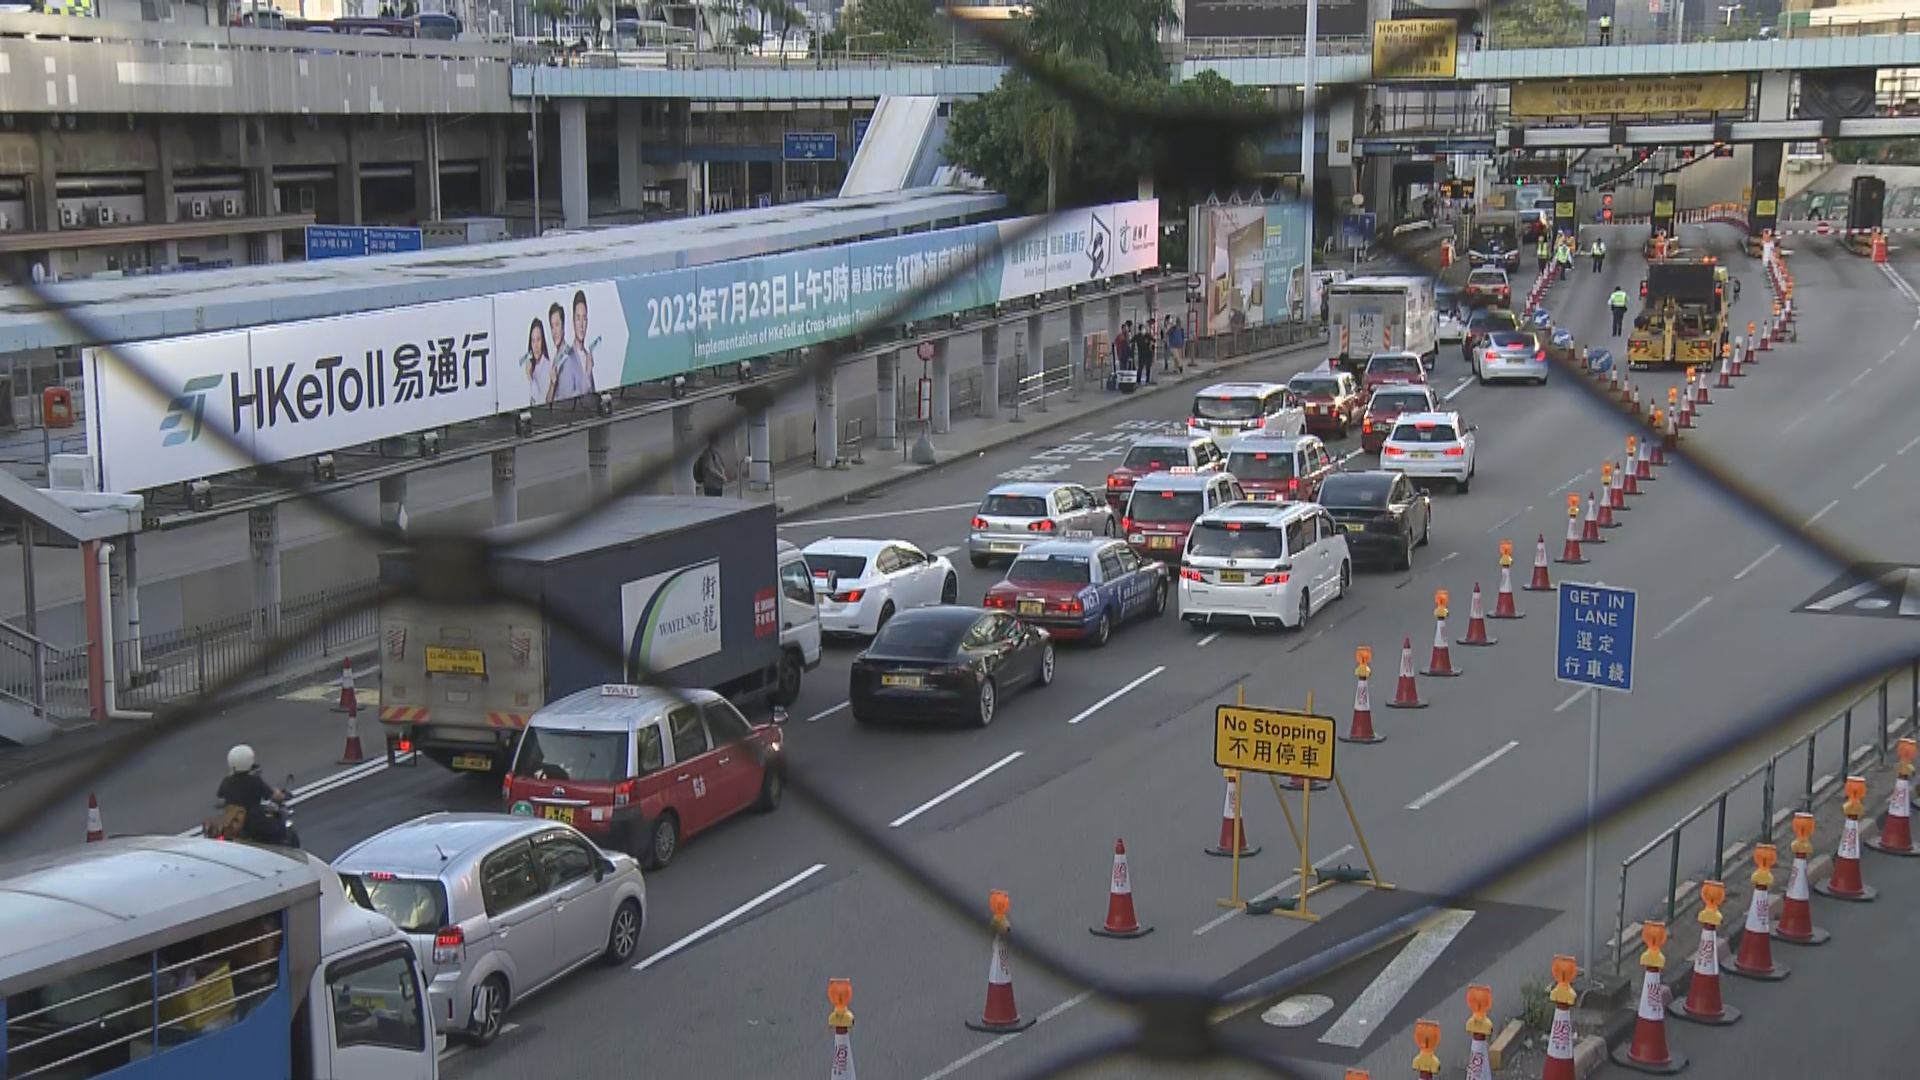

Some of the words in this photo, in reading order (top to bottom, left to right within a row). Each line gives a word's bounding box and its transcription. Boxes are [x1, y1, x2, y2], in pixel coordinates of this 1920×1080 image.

[694, 328, 759, 358] Implementation
[759, 327, 768, 343] of
[768, 322, 797, 340] HKeToll
[797, 321, 805, 335] at
[805, 312, 855, 334] Cross-Harbour
[230, 349, 386, 434] HKeToll
[393, 331, 491, 404] 易通行
[1569, 590, 1600, 605] GET
[1608, 593, 1625, 609] IN
[1575, 608, 1618, 627] LANE
[1576, 630, 1614, 654] 選定
[604, 686, 635, 696] TAXI
[1224, 714, 1247, 731] No
[1253, 718, 1326, 744] Stopping
[1228, 736, 1320, 769] 不用停車
